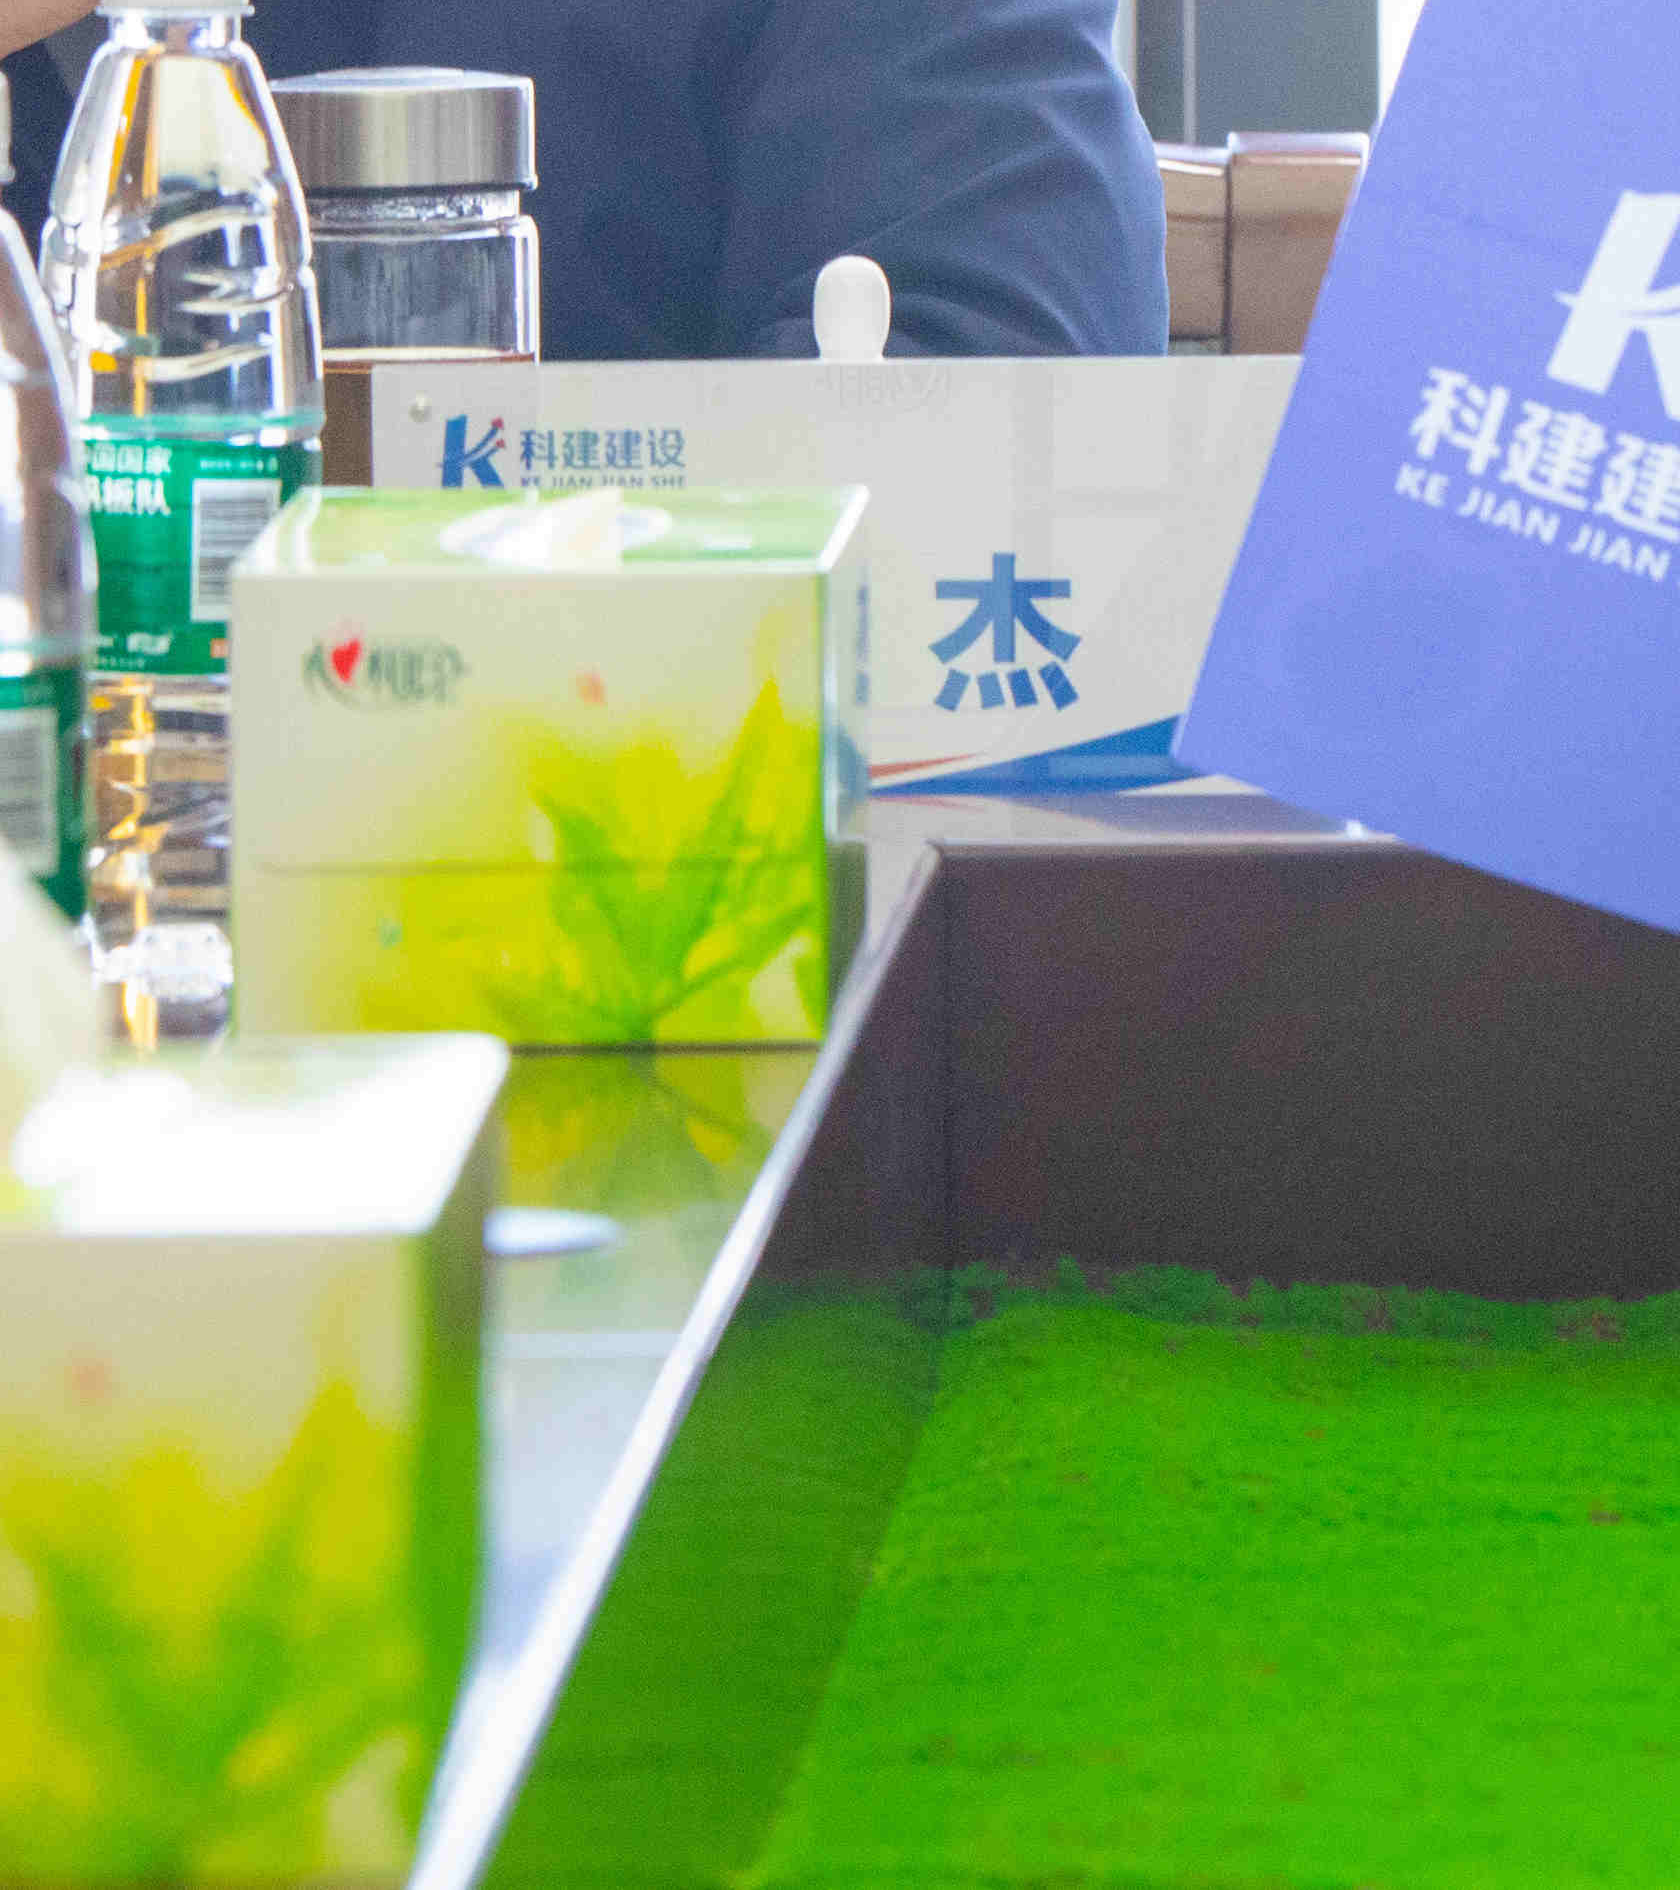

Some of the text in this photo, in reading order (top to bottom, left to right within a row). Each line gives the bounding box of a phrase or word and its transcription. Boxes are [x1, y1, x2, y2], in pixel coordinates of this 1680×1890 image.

[519, 428, 687, 471] 科建建设
[1394, 461, 1450, 508] KE
[1458, 487, 1561, 545] JIAN
[1568, 523, 1672, 583] JIAN
[928, 552, 1081, 712] 杰
